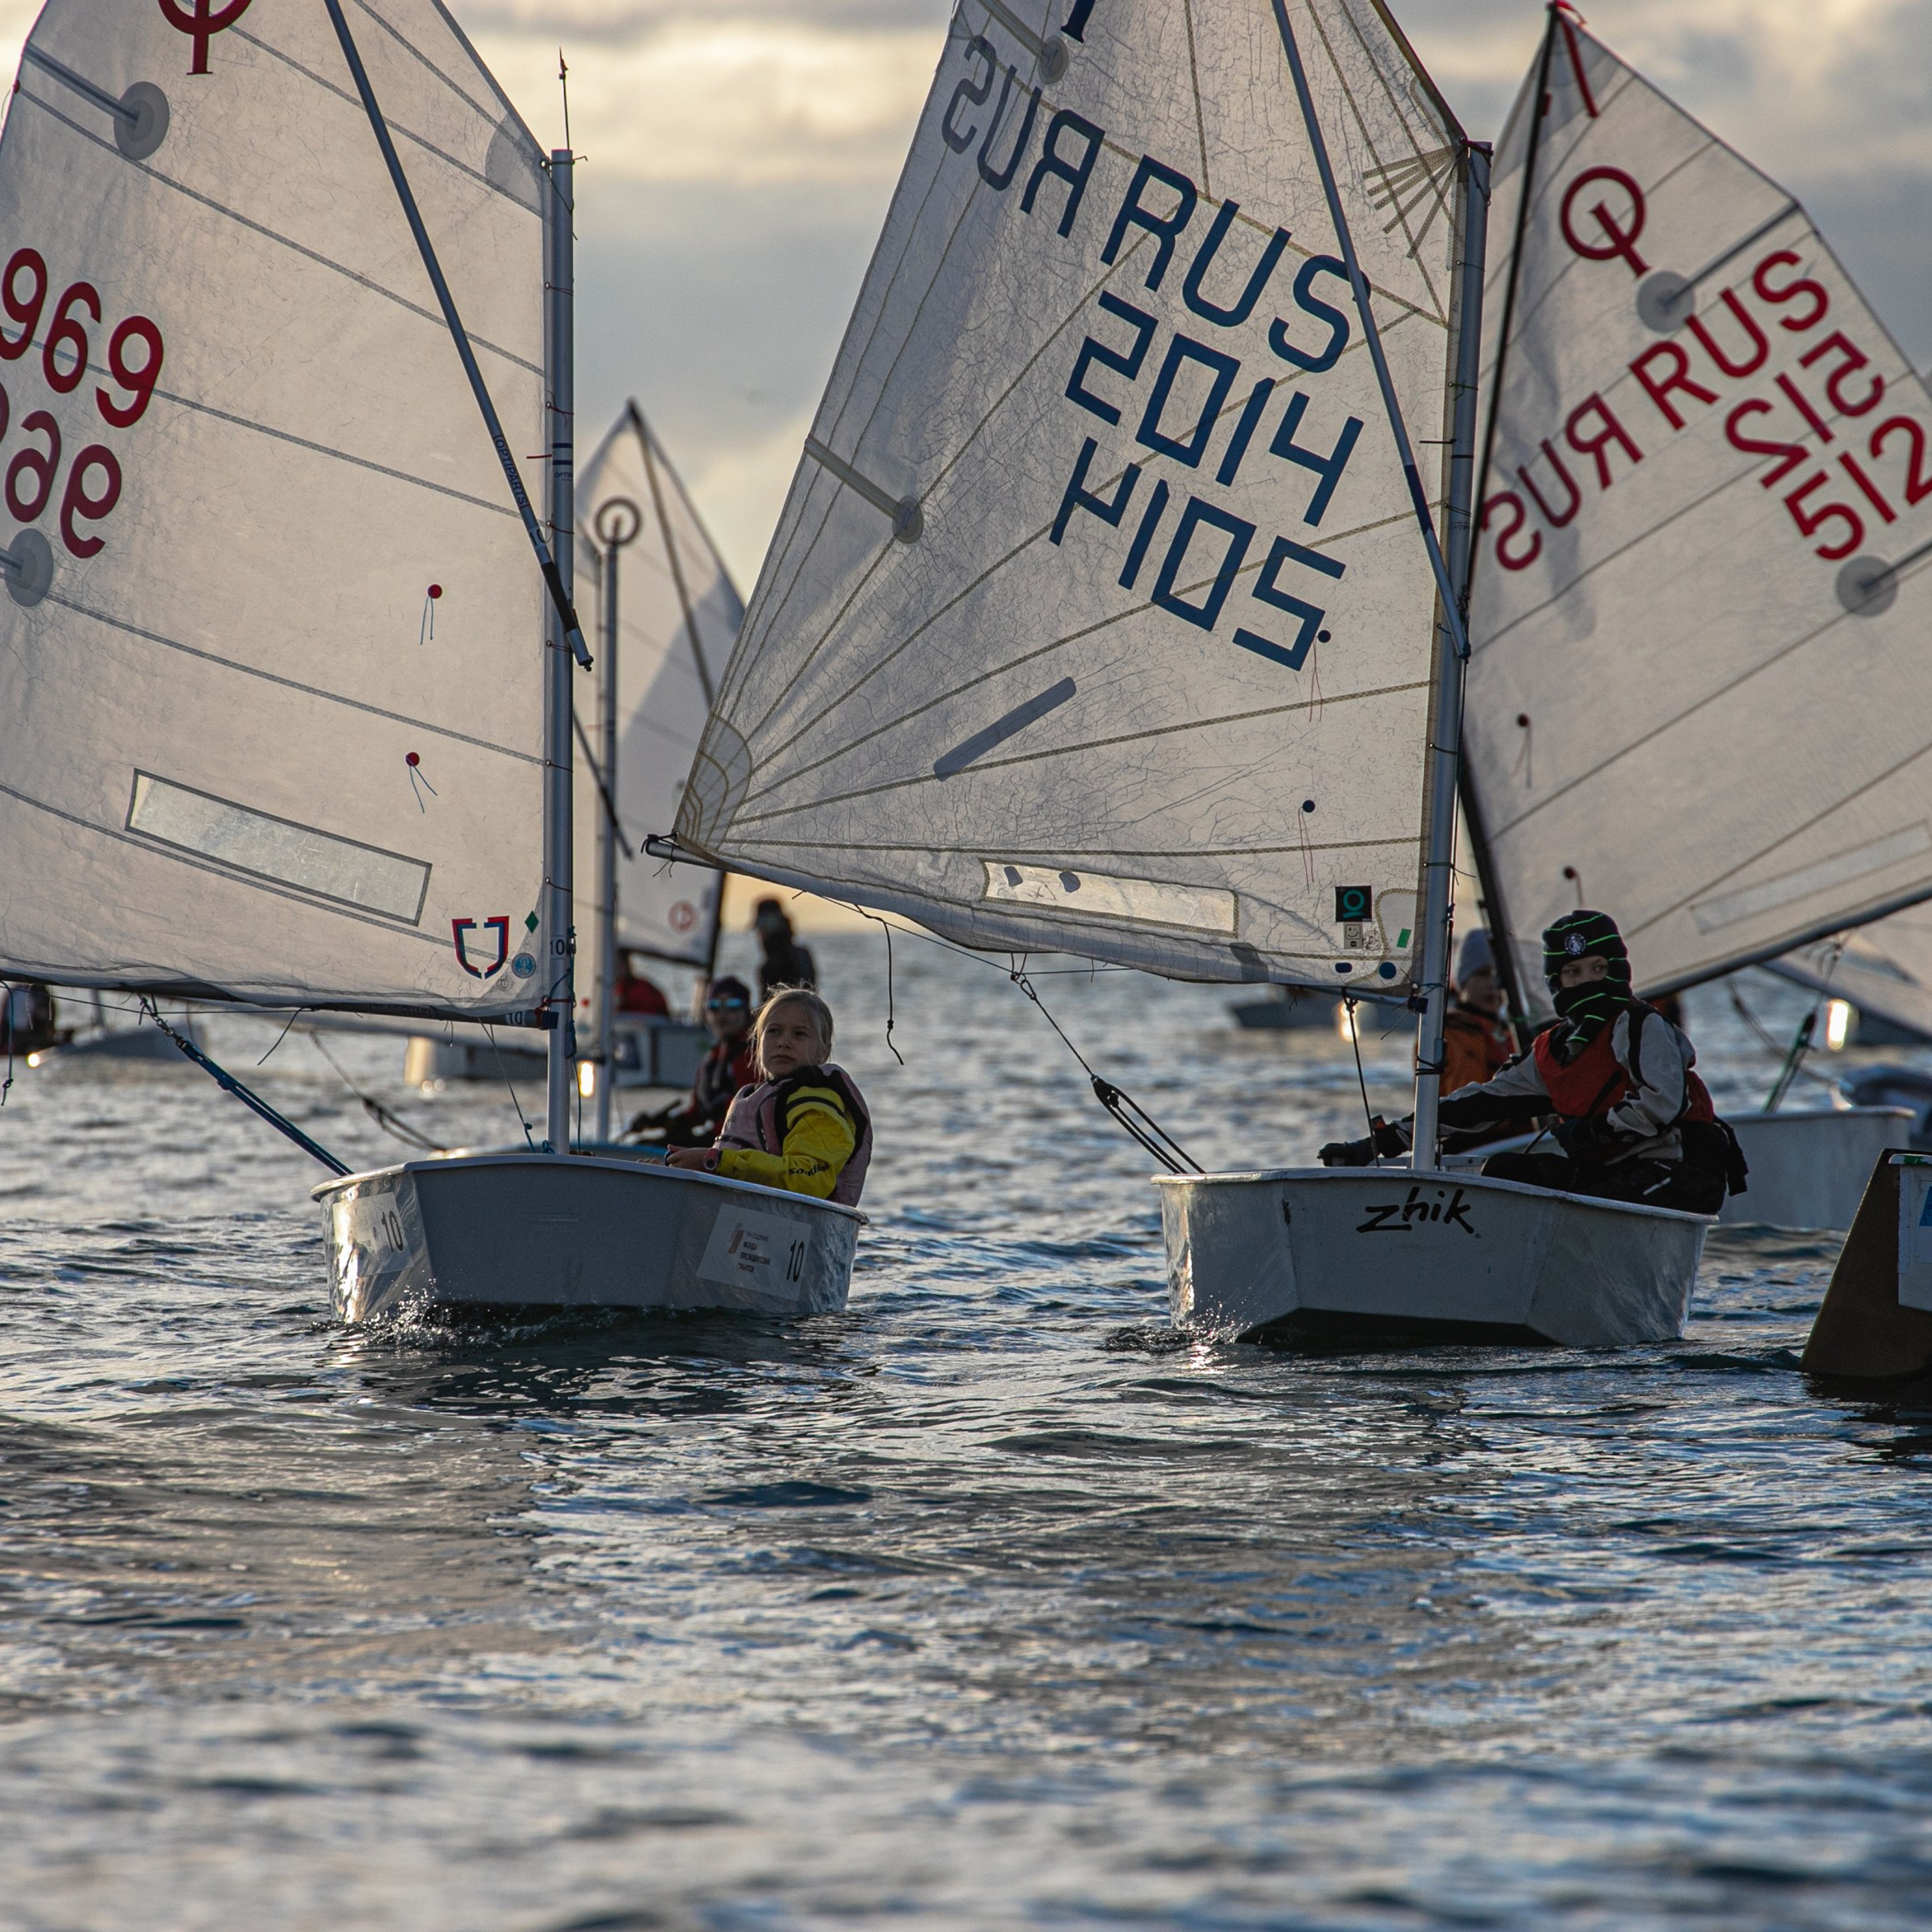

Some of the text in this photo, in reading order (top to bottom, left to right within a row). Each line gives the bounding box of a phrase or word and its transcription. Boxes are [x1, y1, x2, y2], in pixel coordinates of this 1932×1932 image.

[1100, 154, 1371, 374] RUS
[0, 248, 164, 429] 969
[1629, 250, 1829, 431] RUS
[1065, 290, 1364, 527] 2014
[495, 438, 528, 506] OPTIPARTS
[1783, 416, 1932, 561] 512
[550, 939, 565, 955] 10
[381, 1211, 403, 1252] 10
[786, 1239, 805, 1283] 10
[1356, 1186, 1475, 1234] zhik
